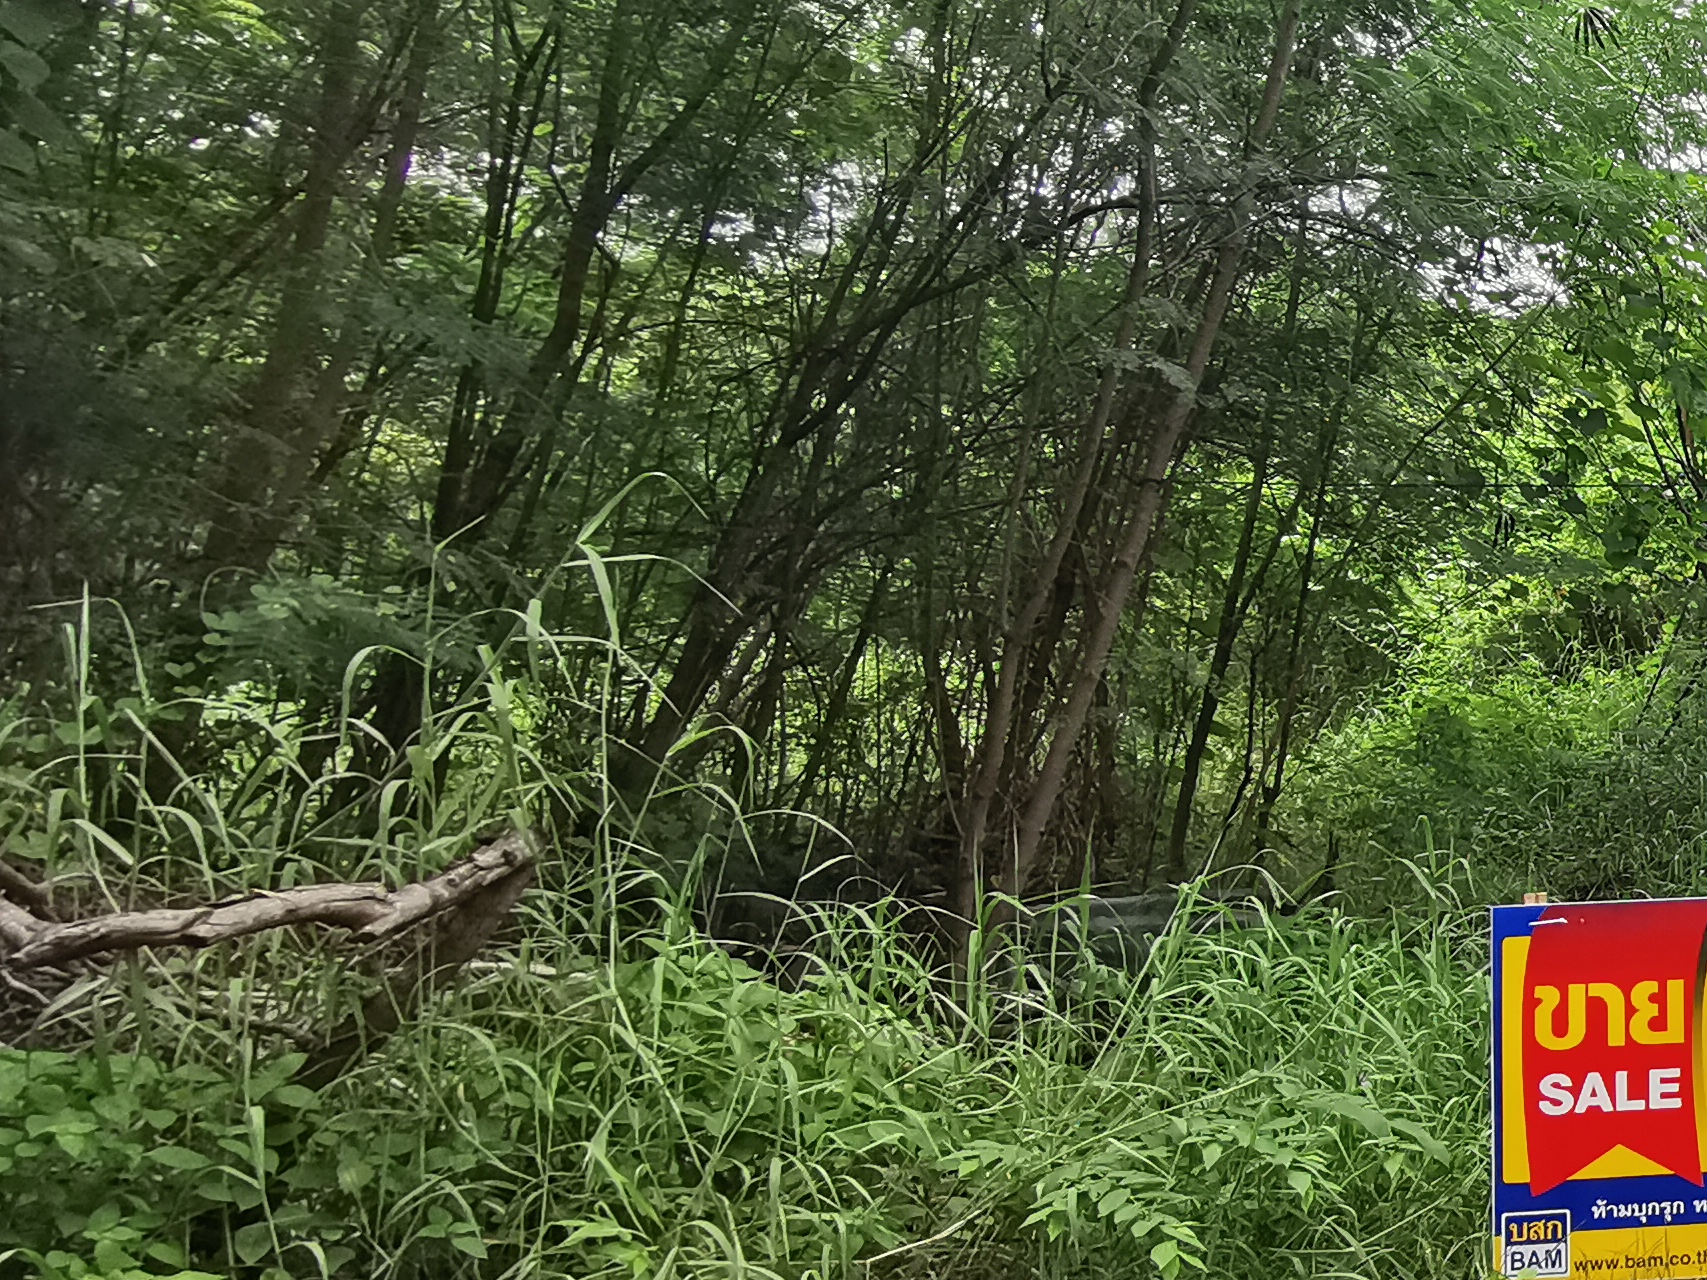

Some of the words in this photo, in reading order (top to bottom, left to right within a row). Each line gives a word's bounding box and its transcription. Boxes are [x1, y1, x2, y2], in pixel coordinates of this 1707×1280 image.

[1534, 979, 1685, 1051] ขาย
[1538, 1068, 1683, 1116] SALE
[1590, 1199, 1685, 1225] ห้ามบุกรุก
[1508, 1219, 1563, 1242] บสก
[1510, 1250, 1563, 1271] BAM
